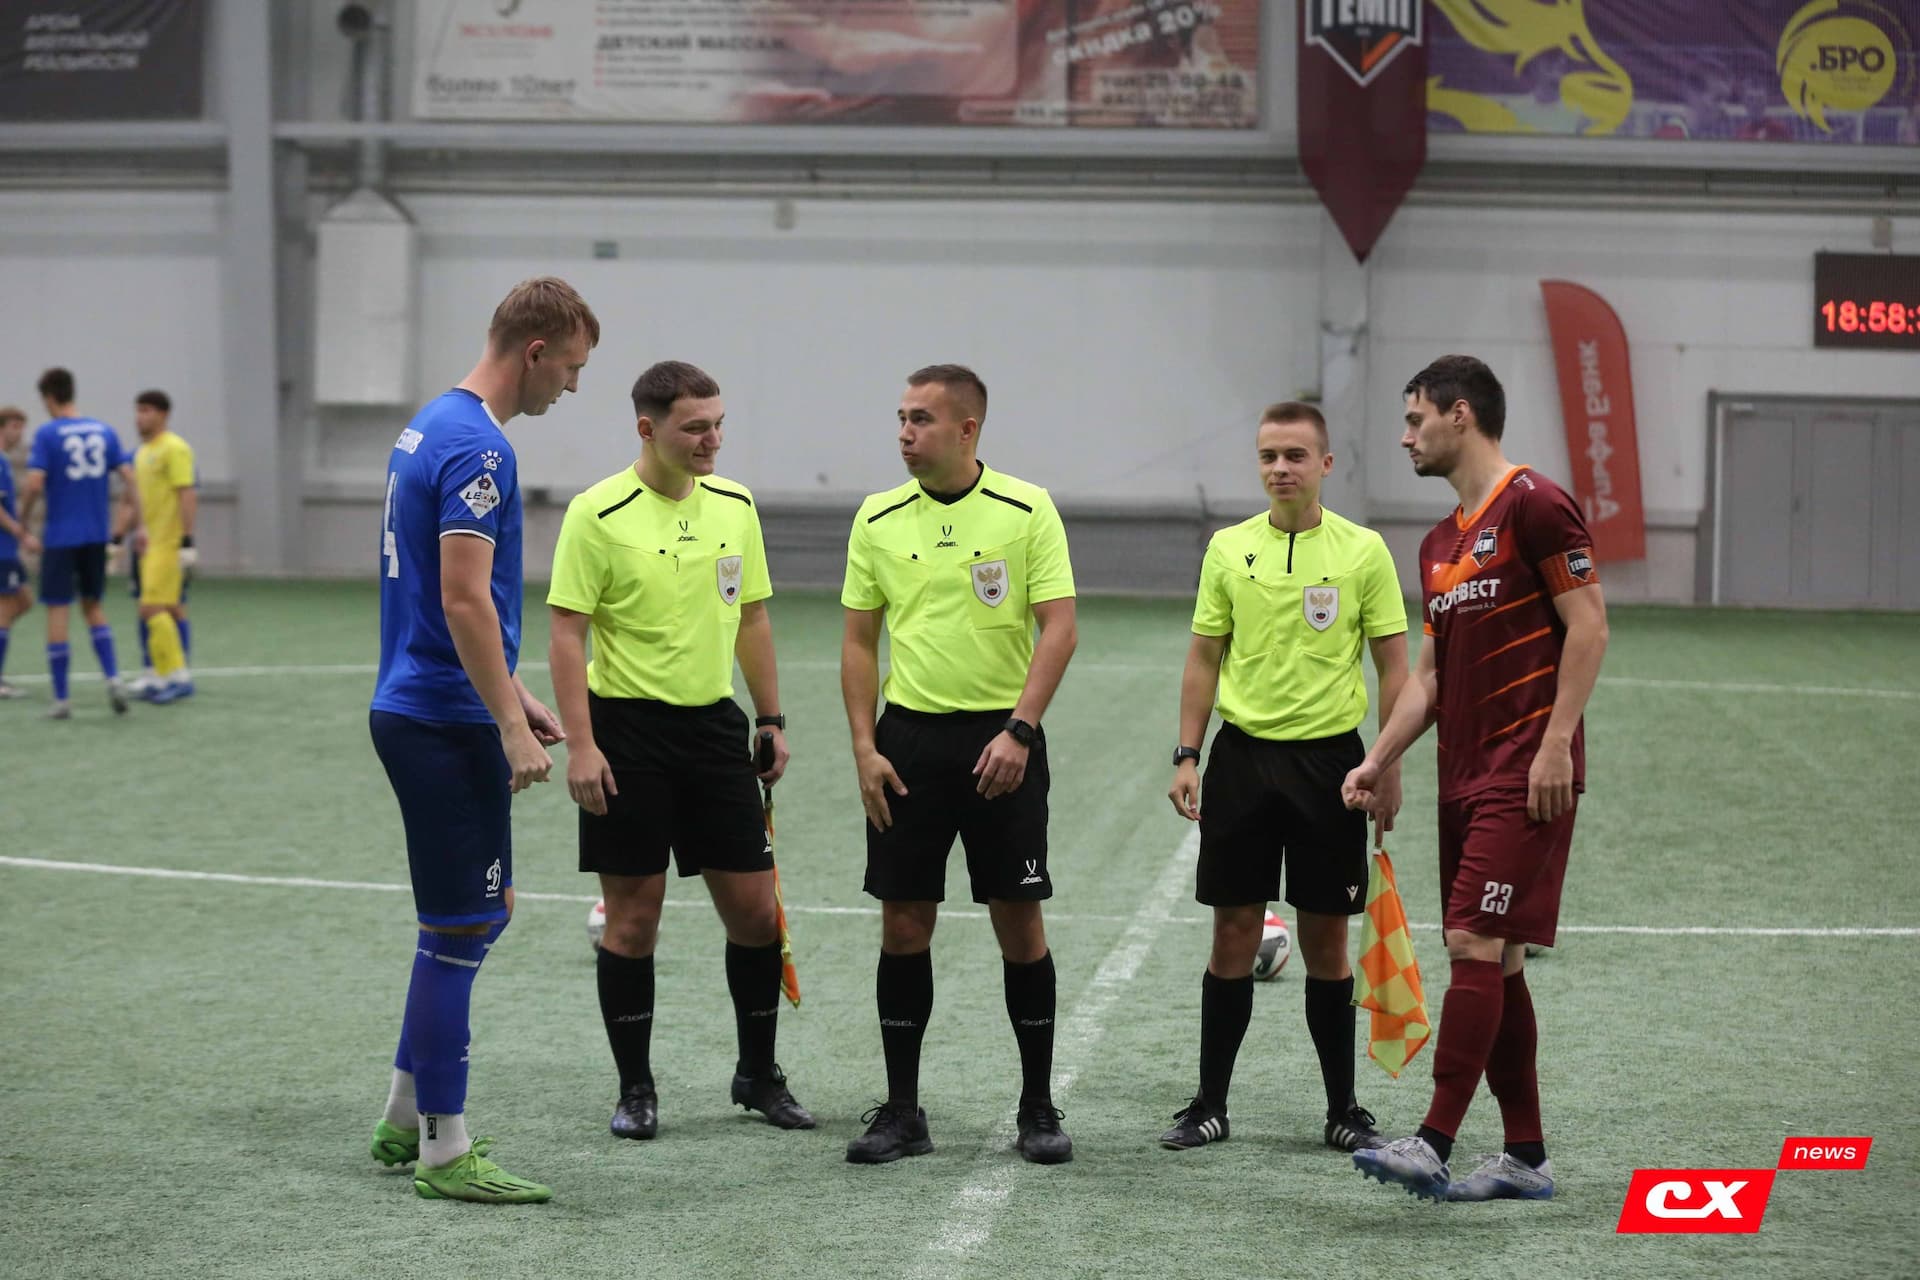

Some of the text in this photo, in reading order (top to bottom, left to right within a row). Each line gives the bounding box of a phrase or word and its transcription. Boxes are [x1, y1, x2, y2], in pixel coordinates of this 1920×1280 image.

[598, 33, 691, 50] ДЕТСКИЙ
[1052, 22, 1151, 64] скидка
[1821, 299, 1920, 334] 18:58:
[63, 434, 106, 479] 33
[1480, 880, 1514, 915] 23
